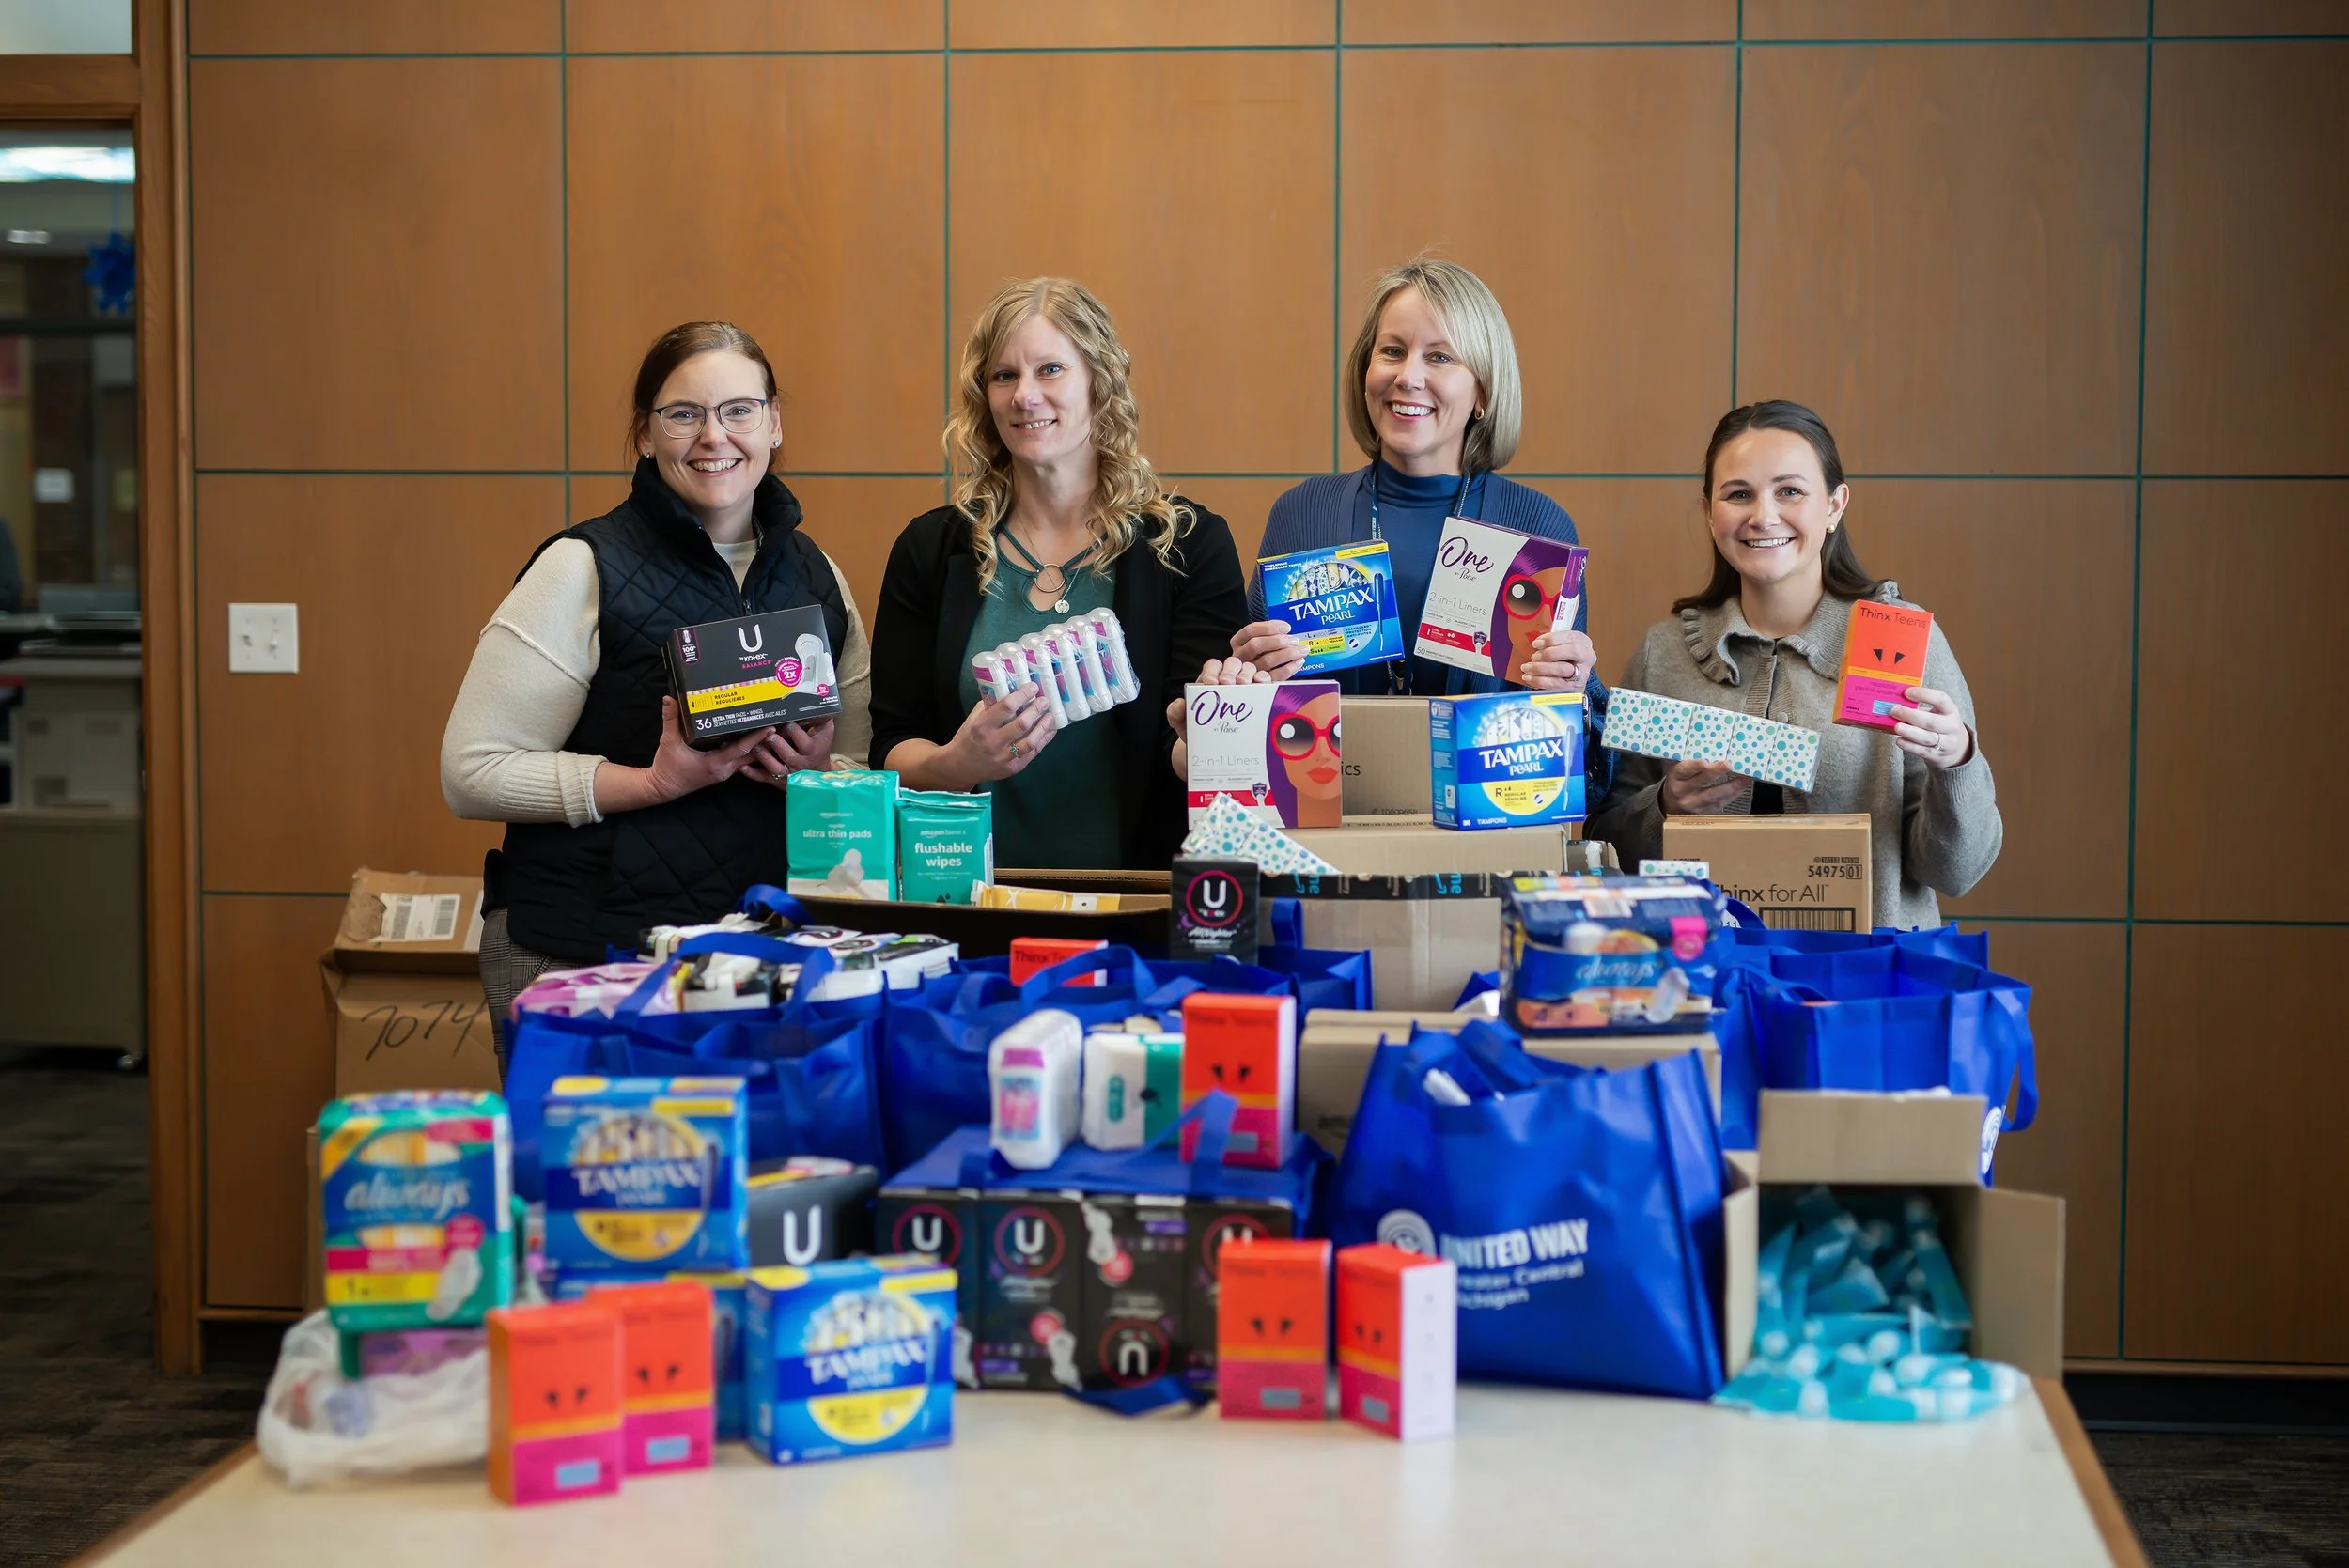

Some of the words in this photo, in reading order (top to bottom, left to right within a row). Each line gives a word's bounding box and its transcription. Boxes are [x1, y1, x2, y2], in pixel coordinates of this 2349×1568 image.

[1440, 536, 1494, 572] One
[1289, 586, 1375, 621] TAMPAX
[1429, 591, 1457, 608] 2-in-1
[1458, 601, 1487, 616] Liners
[1860, 607, 1891, 622] Thinx
[1893, 612, 1926, 629] Teens
[738, 624, 763, 653] U
[1417, 646, 1426, 656] 50
[1299, 662, 1325, 672] AMPONS
[714, 691, 738, 700] REGULAR
[1190, 690, 1253, 726] One
[695, 718, 712, 730] 36
[1192, 755, 1225, 767] 2-in-1
[1227, 754, 1259, 766] Liners
[1479, 738, 1564, 769] TAMPAX
[1496, 787, 1503, 797] R
[802, 829, 825, 838] ultra
[827, 829, 847, 838] thin
[848, 829, 872, 840] pads
[914, 842, 972, 854] flushable
[926, 855, 962, 869] wipes
[1203, 879, 1227, 908] U
[1714, 883, 1765, 902] hinx
[1768, 883, 1797, 902] for
[783, 1203, 822, 1266] U
[911, 1215, 943, 1251] U
[1013, 1219, 1046, 1255] U
[1529, 1218, 1589, 1261] WAY
